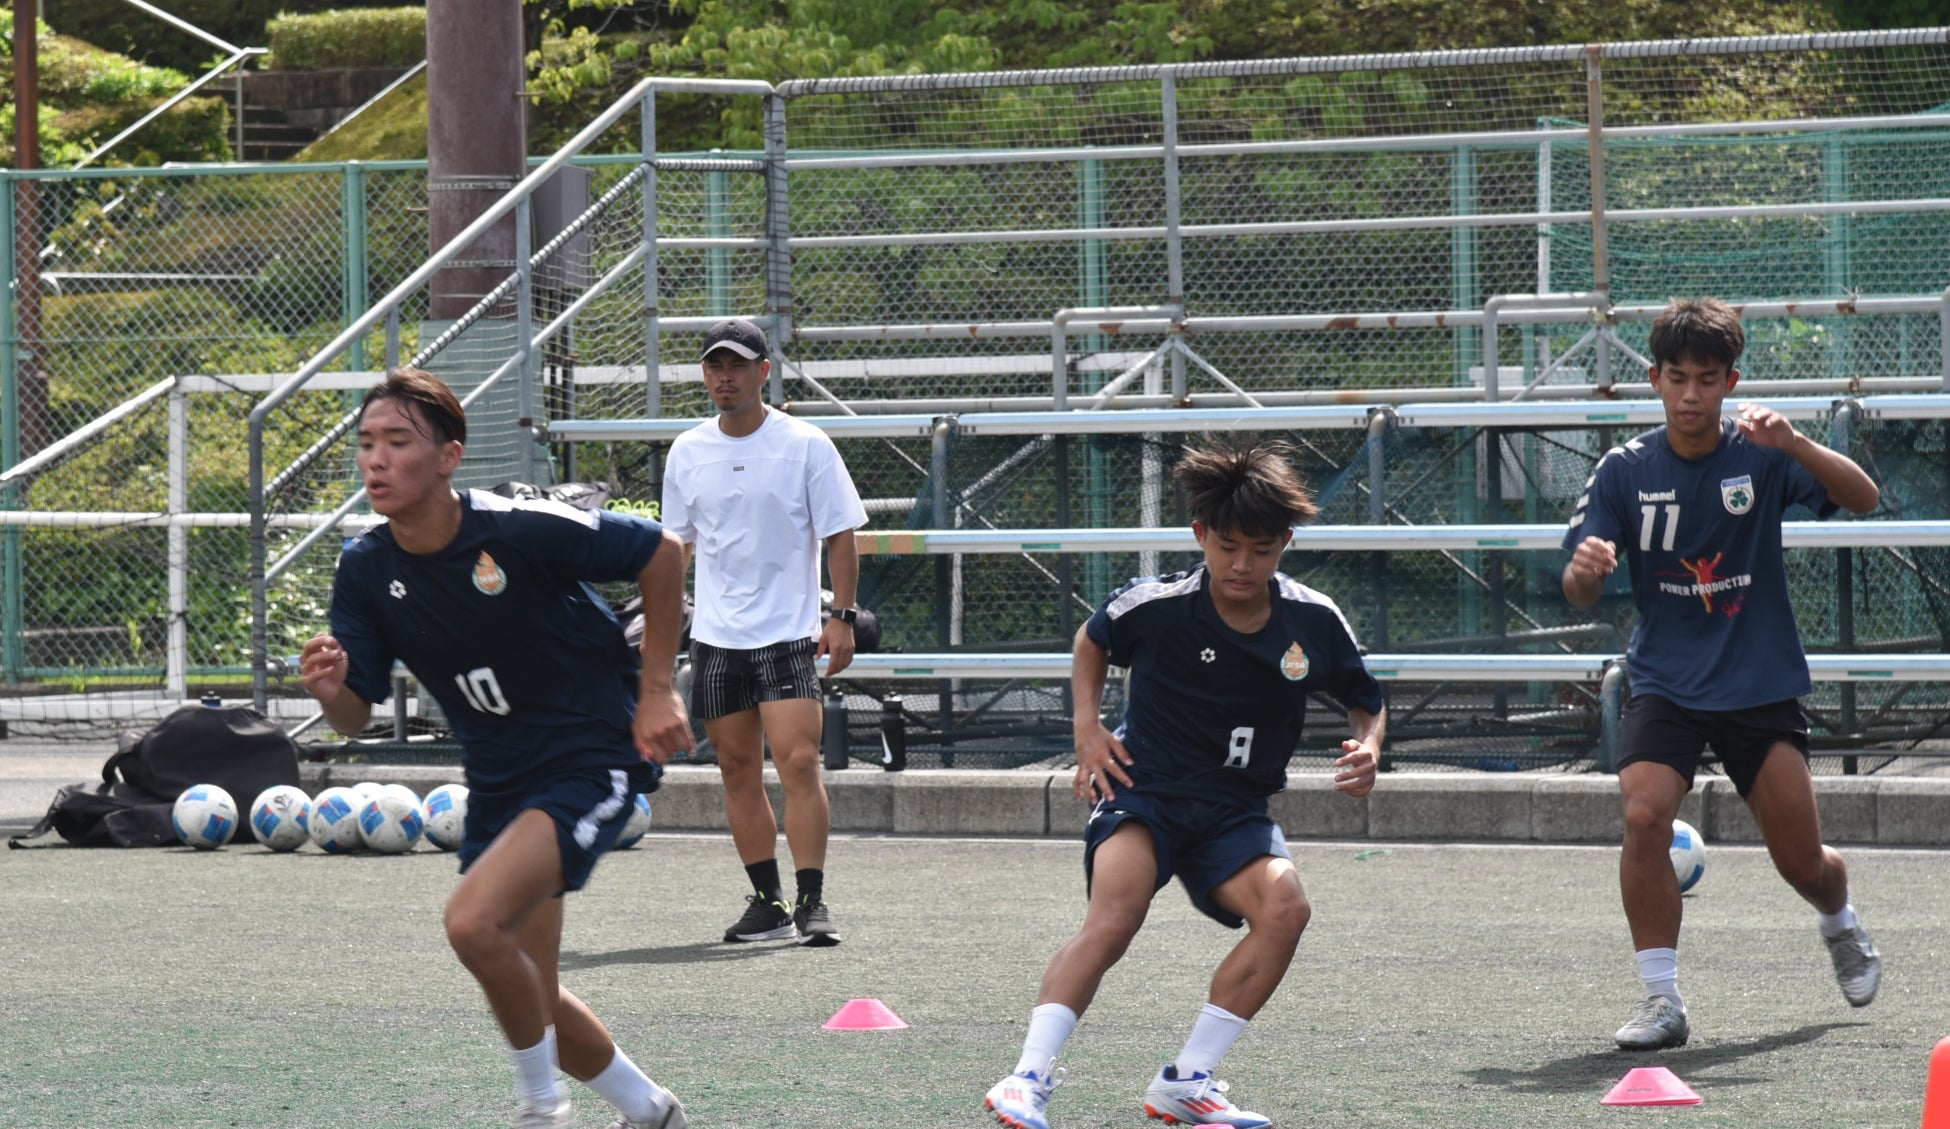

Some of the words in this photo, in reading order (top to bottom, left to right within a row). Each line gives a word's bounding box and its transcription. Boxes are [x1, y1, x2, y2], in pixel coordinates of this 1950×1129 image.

[1638, 489, 1676, 502] hummel
[1639, 504, 1681, 551] 11
[1659, 582, 1691, 596] POWER
[1691, 573, 1752, 596] PRODUCTIN
[454, 666, 512, 716] 10
[1222, 726, 1255, 769] 8
